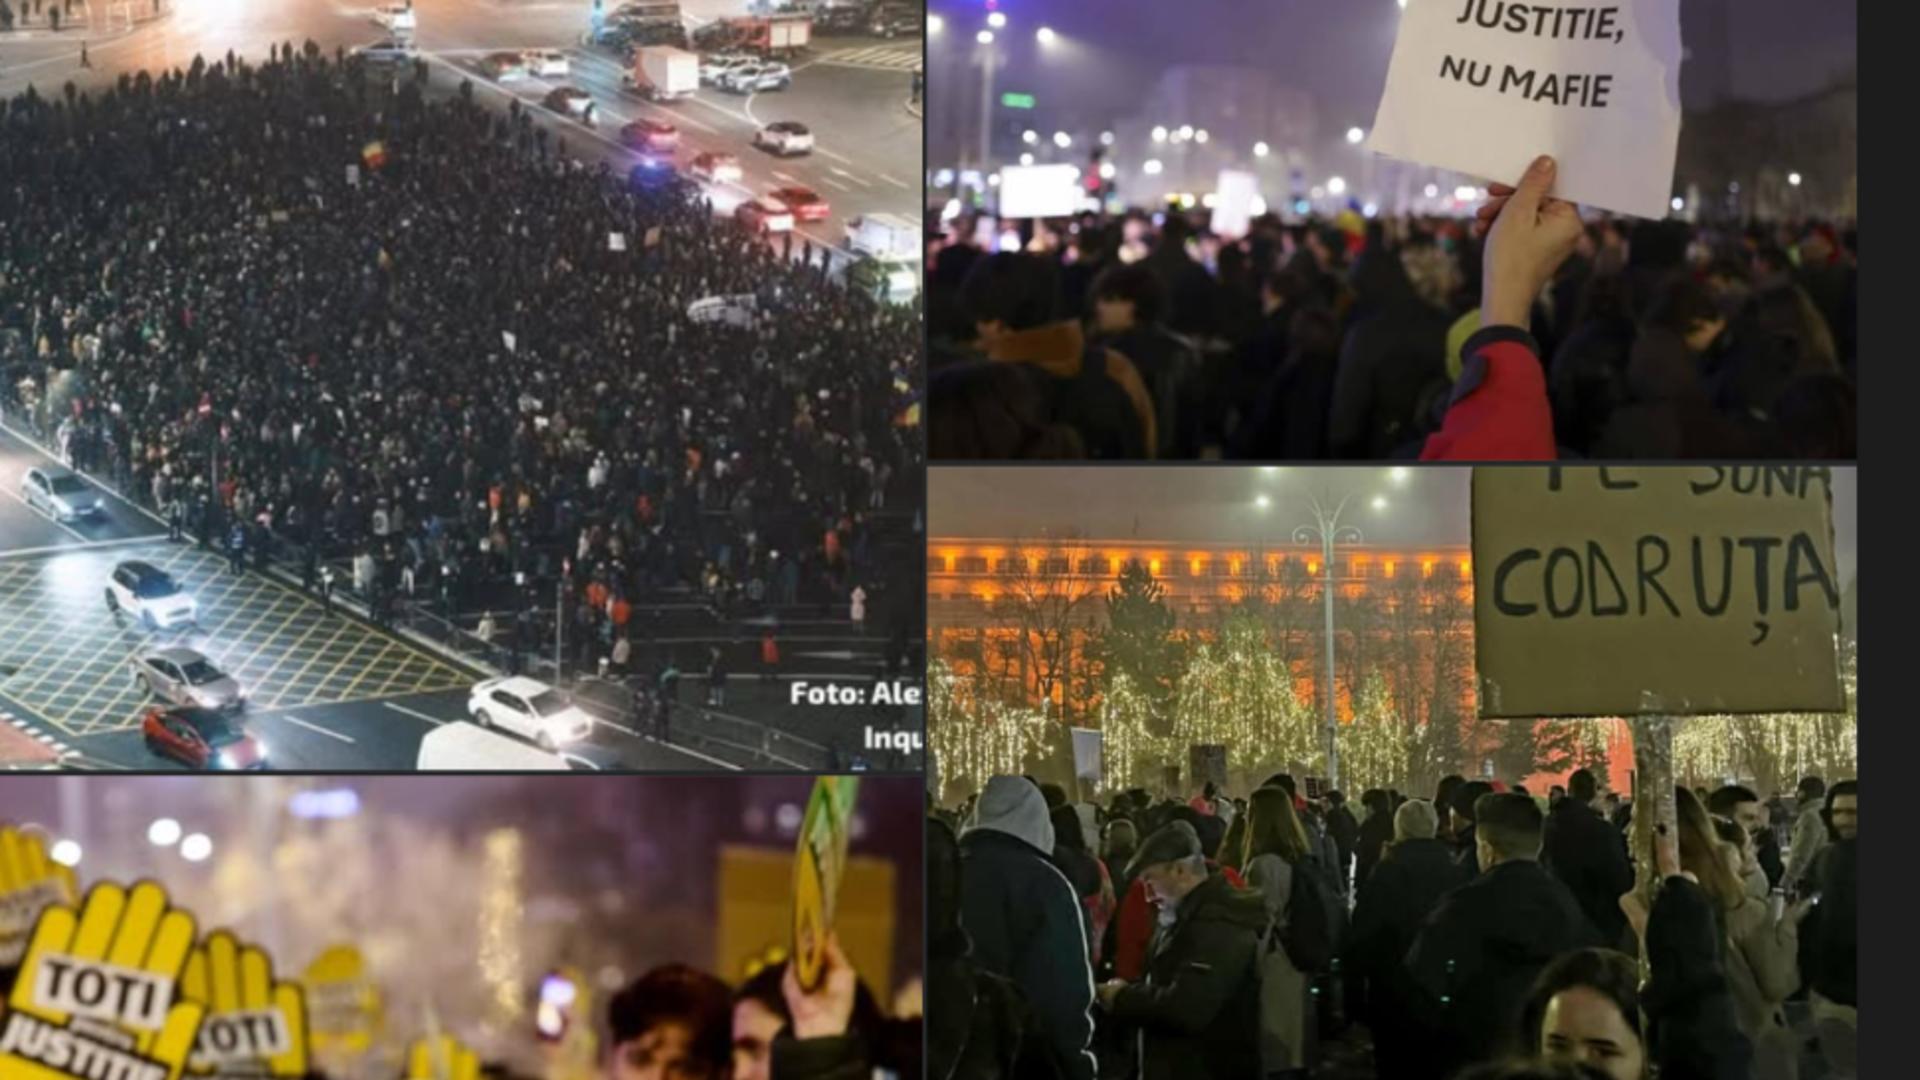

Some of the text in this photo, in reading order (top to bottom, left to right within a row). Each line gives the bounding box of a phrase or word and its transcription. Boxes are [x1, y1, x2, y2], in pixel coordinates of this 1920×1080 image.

[1456, 0, 1624, 44] JUSTITIE,
[1440, 55, 1613, 107] NU MAFIE
[46, 959, 156, 1019] TOTI
[206, 1015, 277, 1053] OTI
